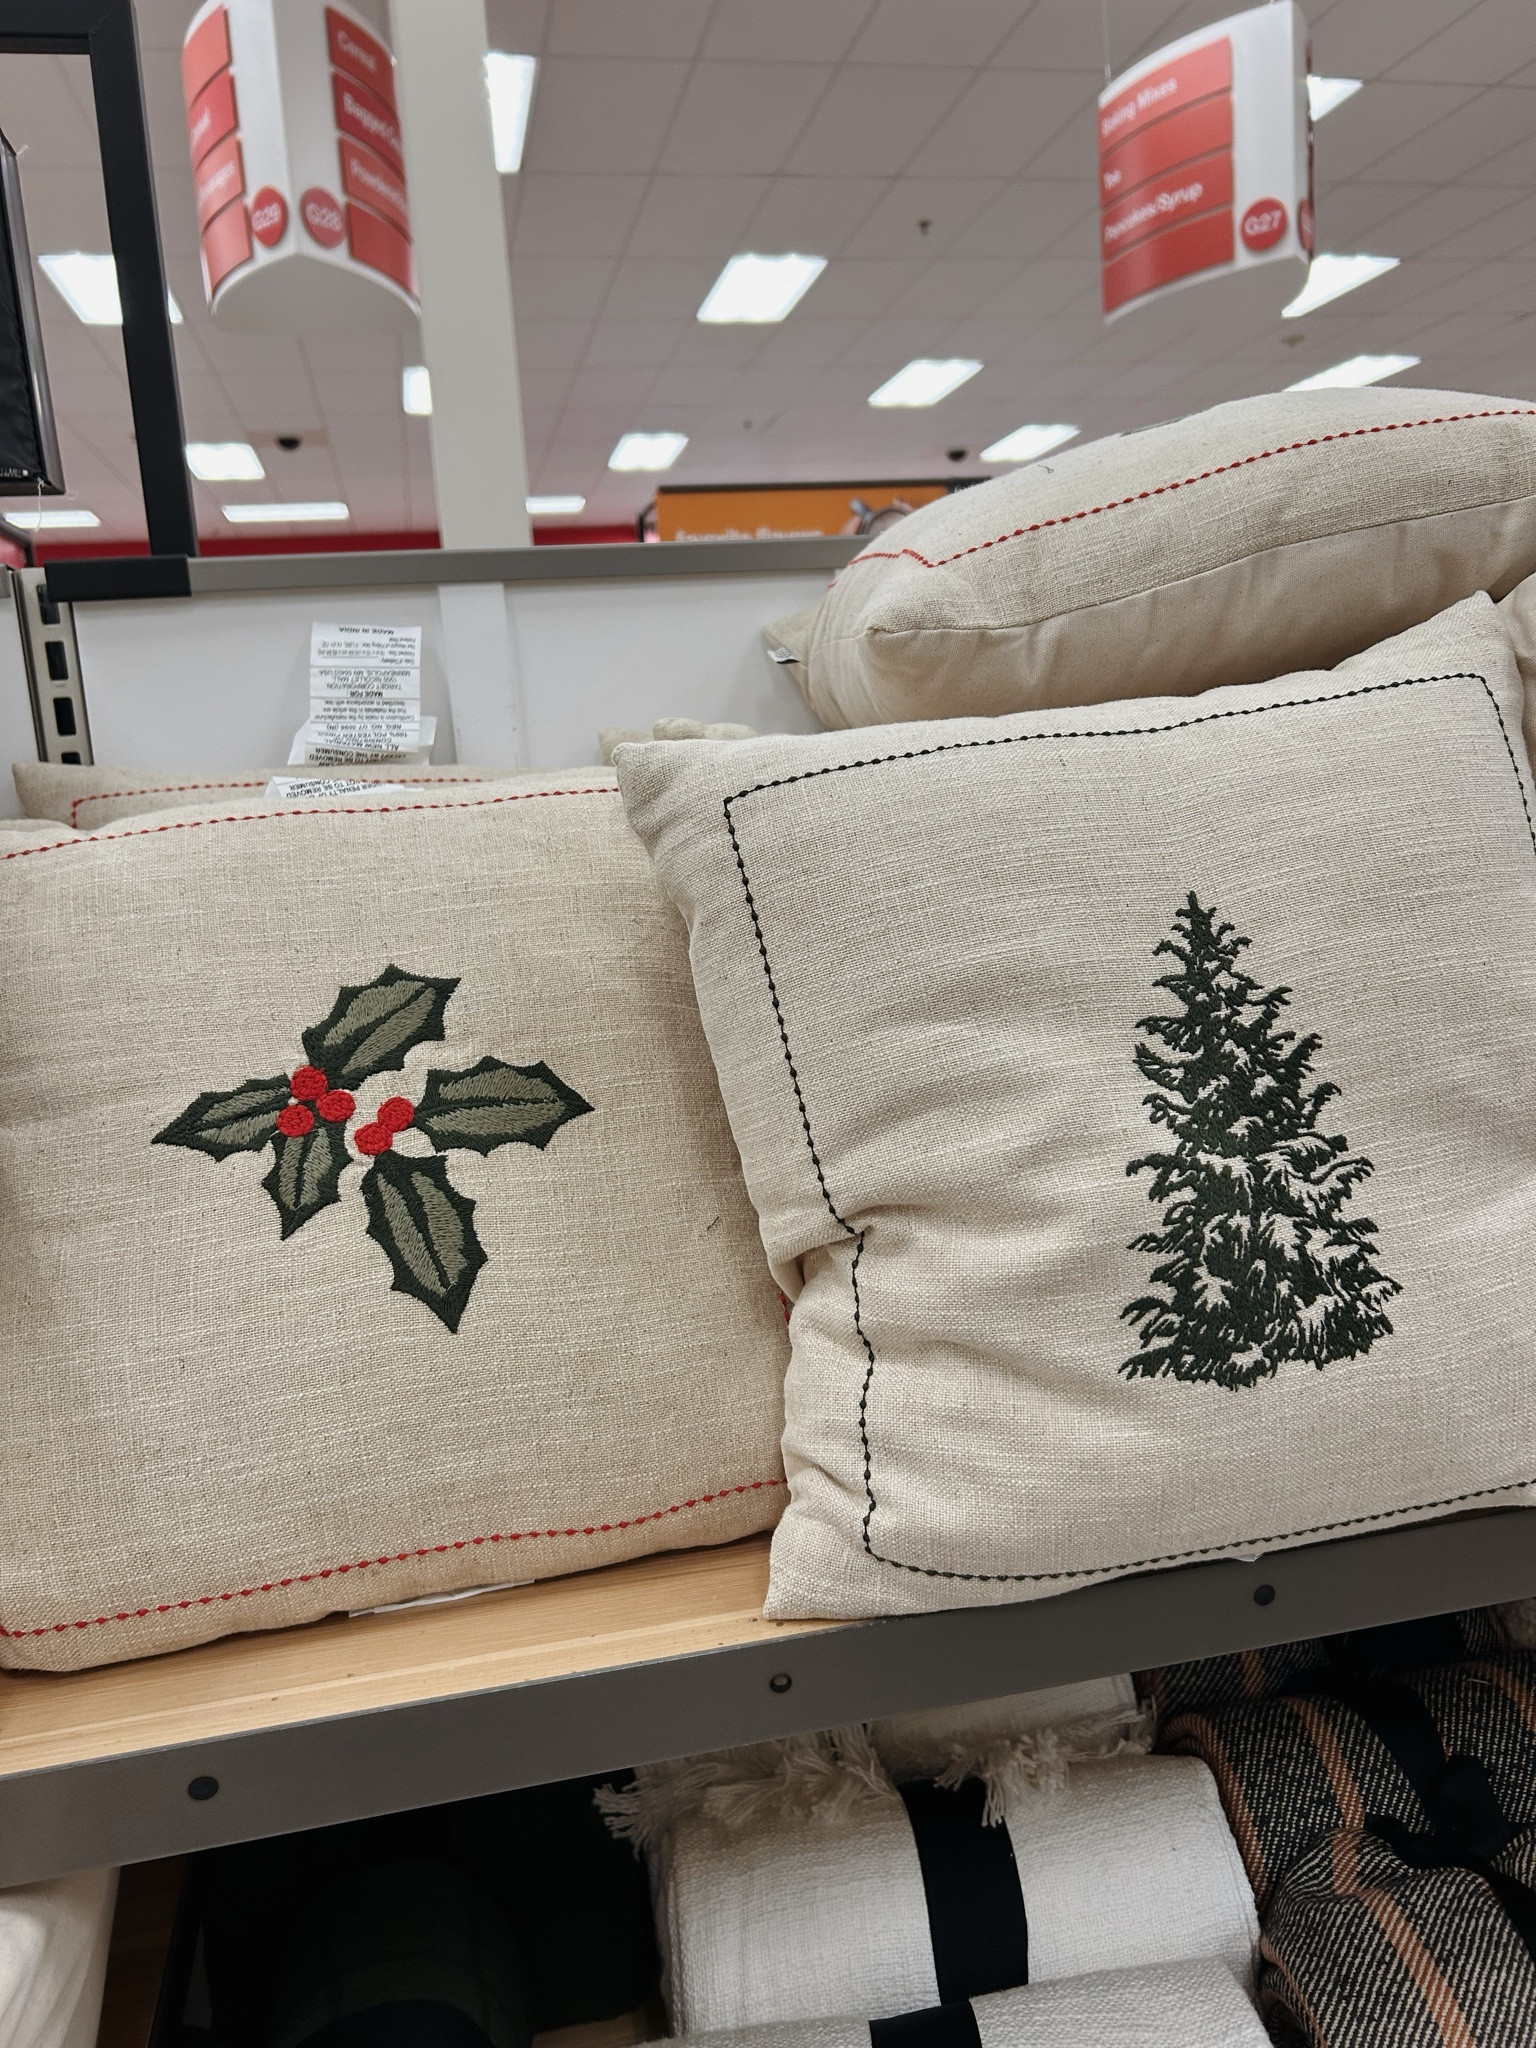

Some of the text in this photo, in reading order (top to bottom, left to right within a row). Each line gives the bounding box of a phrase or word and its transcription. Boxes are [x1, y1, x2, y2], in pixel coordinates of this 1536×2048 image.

[1137, 78, 1177, 109] Mixes
[1103, 169, 1121, 189] Tea
[1244, 209, 1282, 236] G27
[309, 754, 342, 762] REMOVED
[315, 747, 354, 757] CONSUMER
[286, 786, 322, 798] REMOVED
[322, 784, 334, 792] BE
